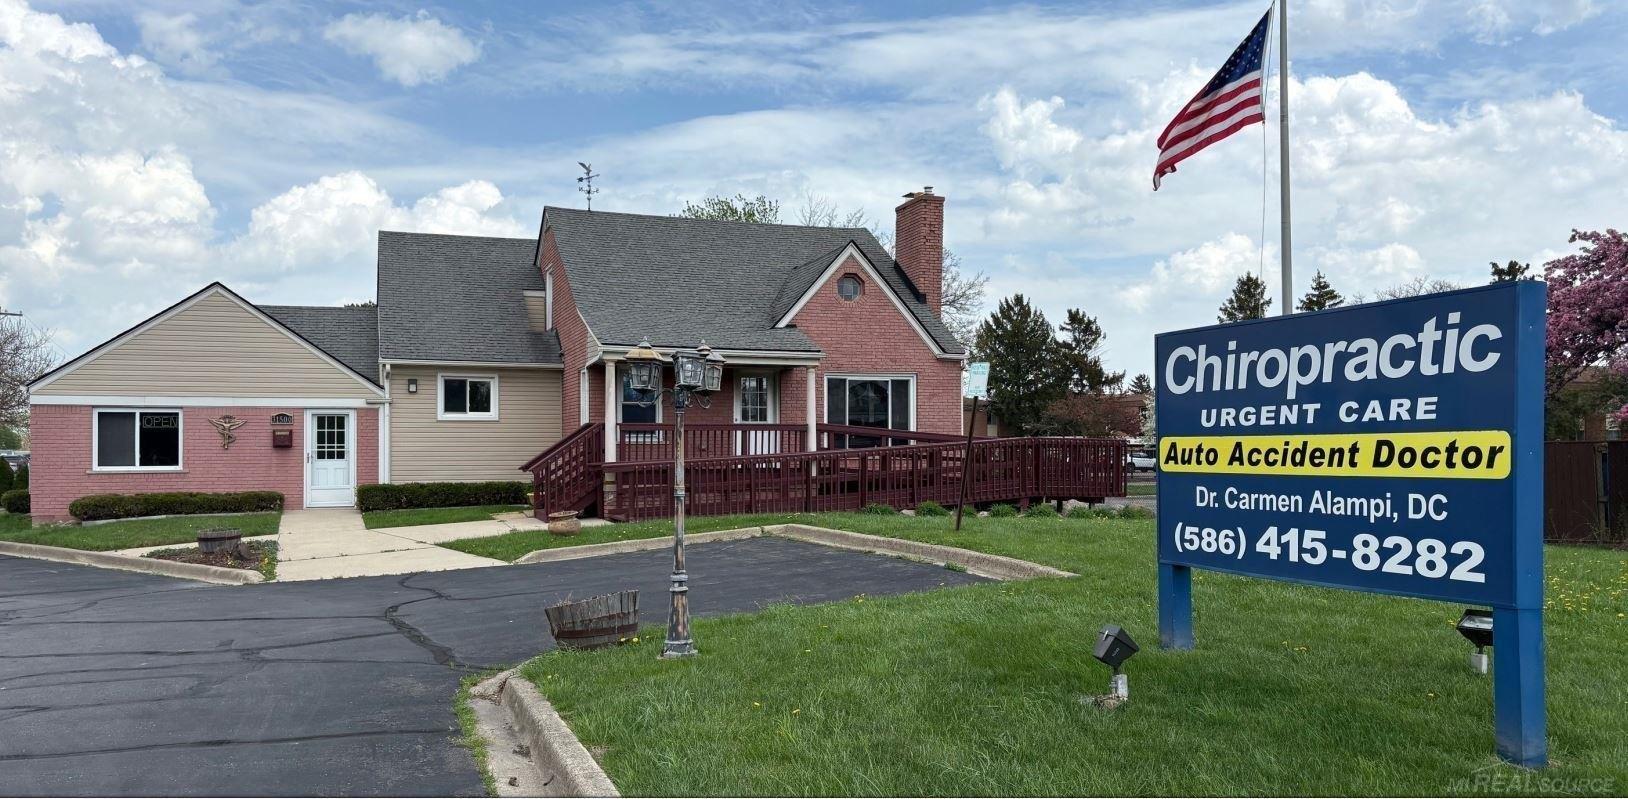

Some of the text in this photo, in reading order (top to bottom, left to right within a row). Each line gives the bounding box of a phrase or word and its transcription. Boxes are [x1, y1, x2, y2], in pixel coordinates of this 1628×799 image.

[1165, 311, 1502, 400] Chiropractic
[144, 416, 178, 428] OPEN
[1201, 397, 1438, 427] URGENT CARE
[1164, 439, 1505, 470] Auto Accident Doctor
[1196, 486, 1448, 523] Dr. Carmen Alampi, DC
[1174, 522, 1486, 583] (586) 415-8282
